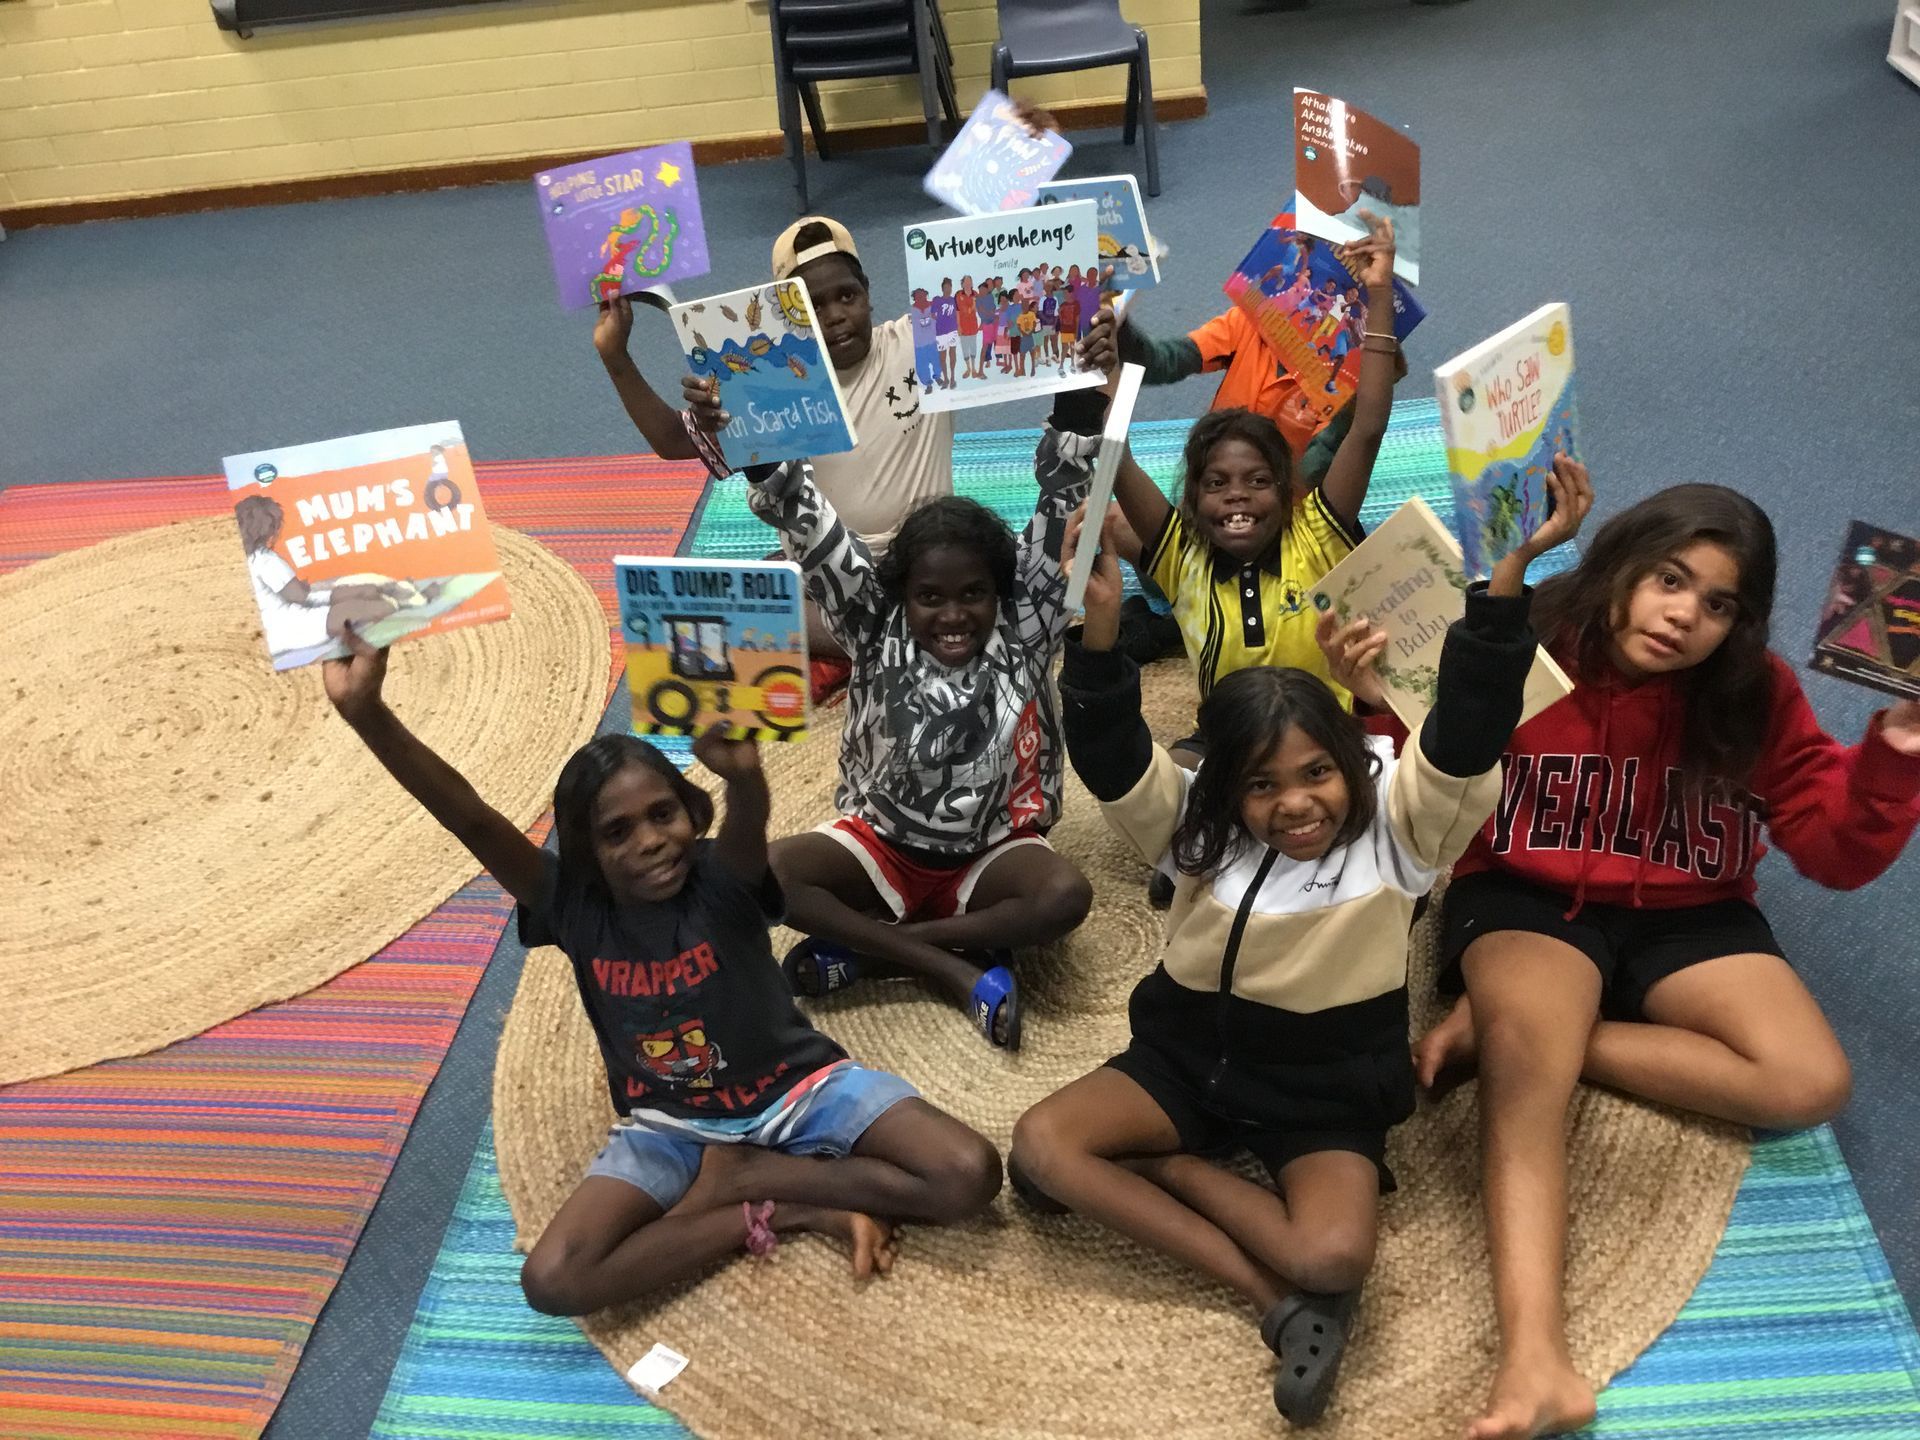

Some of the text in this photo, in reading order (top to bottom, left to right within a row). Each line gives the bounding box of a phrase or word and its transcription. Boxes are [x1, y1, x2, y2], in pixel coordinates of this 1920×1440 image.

[604, 169, 645, 196] STAR
[925, 223, 1075, 261] Artweyenhenge
[993, 258, 1019, 270] Family
[748, 402, 800, 434] Scared
[802, 397, 838, 426] Fish
[295, 478, 415, 527] MUM'S
[285, 503, 474, 569] ELEPHANT
[625, 569, 792, 600] DIG, DUMP, ROLL
[1357, 566, 1436, 627] Reading
[1399, 608, 1418, 626] to
[1396, 614, 1450, 658] Baby
[1481, 752, 1766, 881] VERLAST
[827, 964, 839, 990] NIKE
